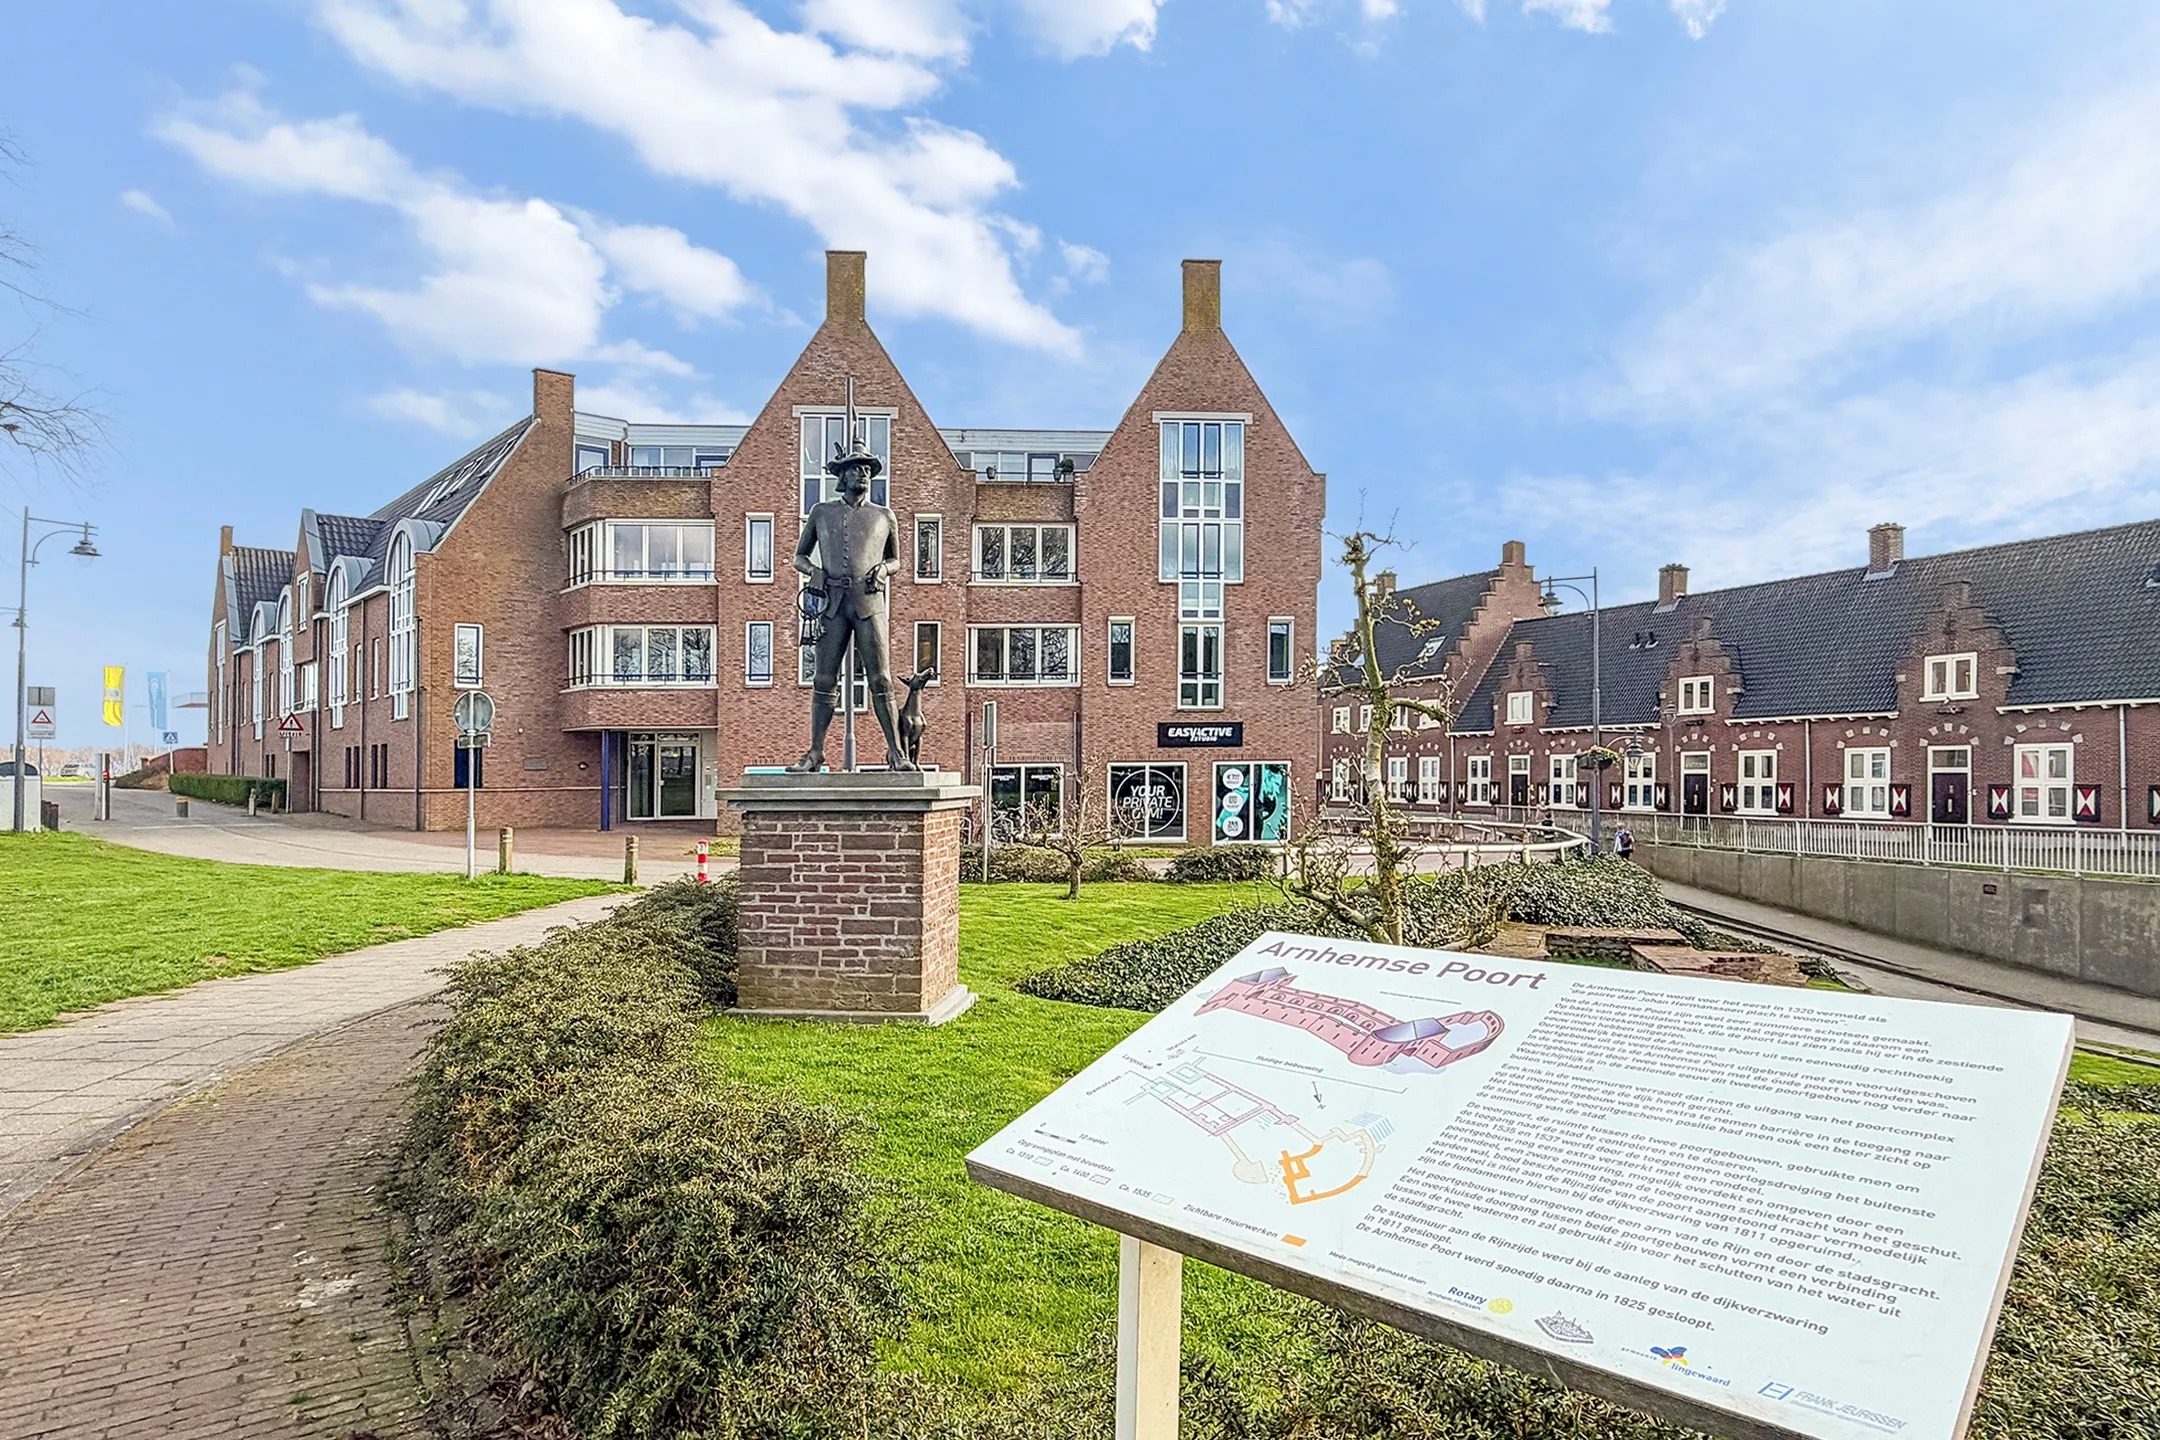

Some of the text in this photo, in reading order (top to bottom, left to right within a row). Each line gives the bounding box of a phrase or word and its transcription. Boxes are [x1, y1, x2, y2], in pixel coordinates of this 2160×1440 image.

[1122, 796, 1173, 808] PRIVATE
[1130, 785, 1166, 797] YOUR
[1257, 940, 1547, 990] Arnhemse Poort
[1256, 1055, 1324, 1074] Huidige bebouwing
[1500, 1062, 1520, 1071] Een
[1520, 1066, 1543, 1075] knik
[1544, 1069, 1554, 1077] in
[1571, 1075, 1632, 1090] weermuren
[1634, 1086, 1683, 1098] verraadt
[1684, 1094, 1704, 1102] dat
[1705, 1097, 1733, 1106] men
[1753, 1105, 1801, 1119] uitgang
[1804, 1113, 1827, 1122] van
[1830, 1116, 1853, 1126] het
[1454, 1115, 1489, 1128] Tussen
[1491, 1123, 1516, 1134] 1535
[1534, 1132, 1560, 1142] 1537
[1561, 1138, 1594, 1150] wordt
[1595, 1145, 1623, 1155] door
[1624, 1151, 1640, 1159] de
[1642, 1154, 1720, 1175] toegenomen
[1723, 1171, 1832, 1199] oorlogsdreiging
[1835, 1192, 1860, 1203] het
[1862, 1197, 1935, 1218] buitenste
[1133, 1187, 1152, 1198] 1535
[1383, 1192, 1463, 1218] de stadsgracht.
[1417, 1155, 1854, 1261] zijn de fundamenten hiervan bij de dijkverzwaring van 1811 opgeruimd.
[1431, 1140, 1961, 1260] aarden wal, bood bescherming tegen de toegenomen schietkracht van het geschut.
[1183, 1203, 1278, 1239] Zichtbare muurwerken
[1363, 1212, 1451, 1244] in 1811 gesloopt.
[1399, 1174, 1897, 1304] Een overkluisde doorgang tussen beide poortgebouwen vormt een verbinding
[1406, 1166, 1939, 1300] Het poortgebouw werd omgeven door een arm van de Rijn en door de stadsgracht.
[1347, 1256, 1375, 1271] mogelijk
[1376, 1266, 1407, 1280] gemaakt
[1391, 1183, 1901, 1317] tussen de twee wateren en zal gebruikt zijn voor het schutten van het water uit
[1355, 1222, 1714, 1331] De Arnhemse Poort werd spoedig daarna in 1825 gesloopt.
[1371, 1204, 1828, 1335] De stadsmuur aan de Rijnzijde werd bij de aanleg van de dijkverzwaring
[1448, 1286, 1487, 1305] Rotary
[1671, 1362, 1731, 1387] lingewaard
[1794, 1391, 1837, 1409] FRANK
[1836, 1404, 1907, 1429] JEURISSEN
